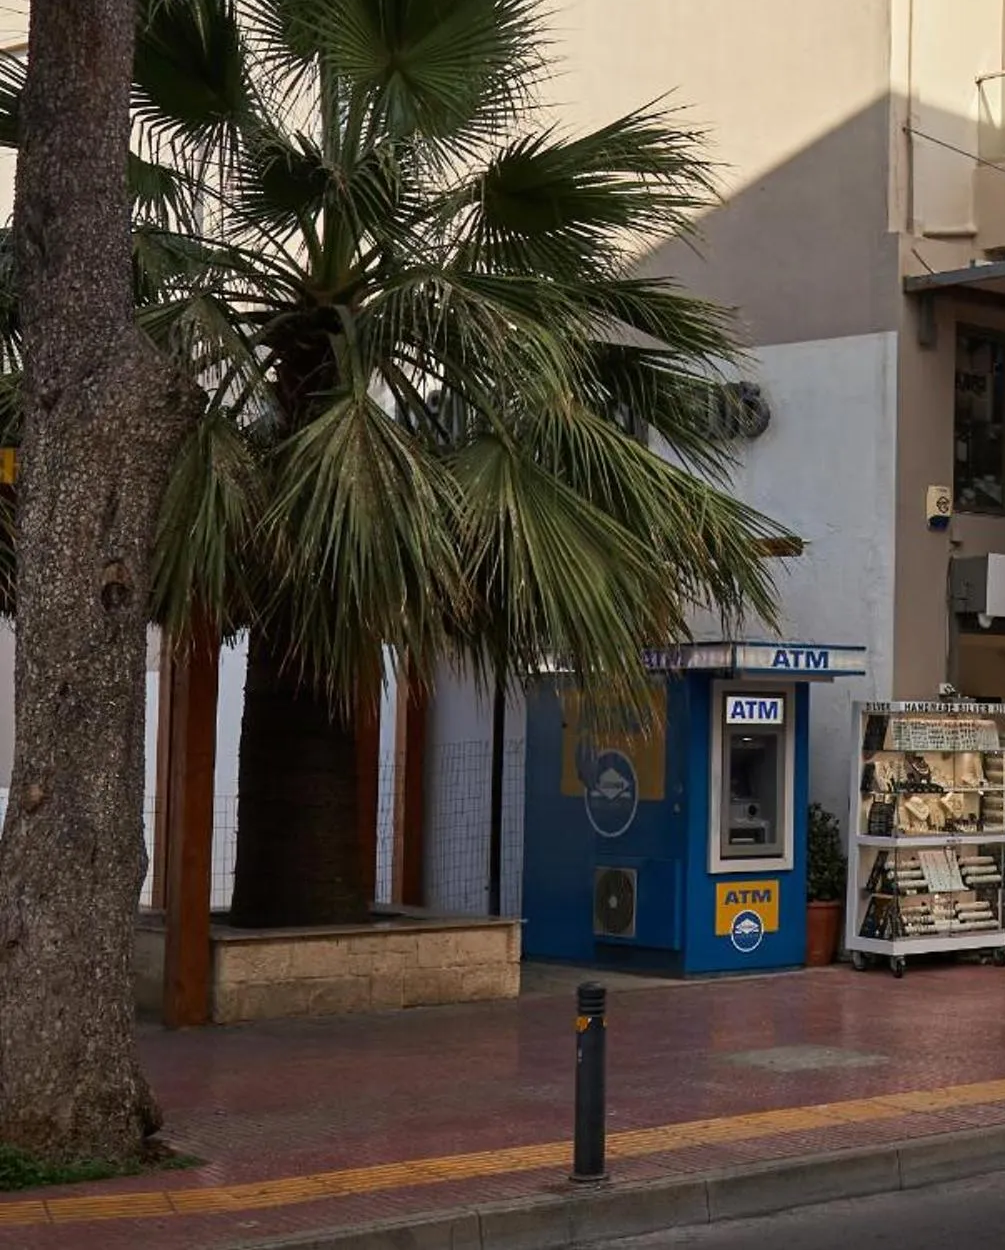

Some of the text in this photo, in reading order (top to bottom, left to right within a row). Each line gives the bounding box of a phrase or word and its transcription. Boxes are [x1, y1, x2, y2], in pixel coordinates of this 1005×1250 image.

[772, 649, 829, 669] ATM
[731, 700, 778, 720] ATM
[724, 889, 772, 905] ATM
